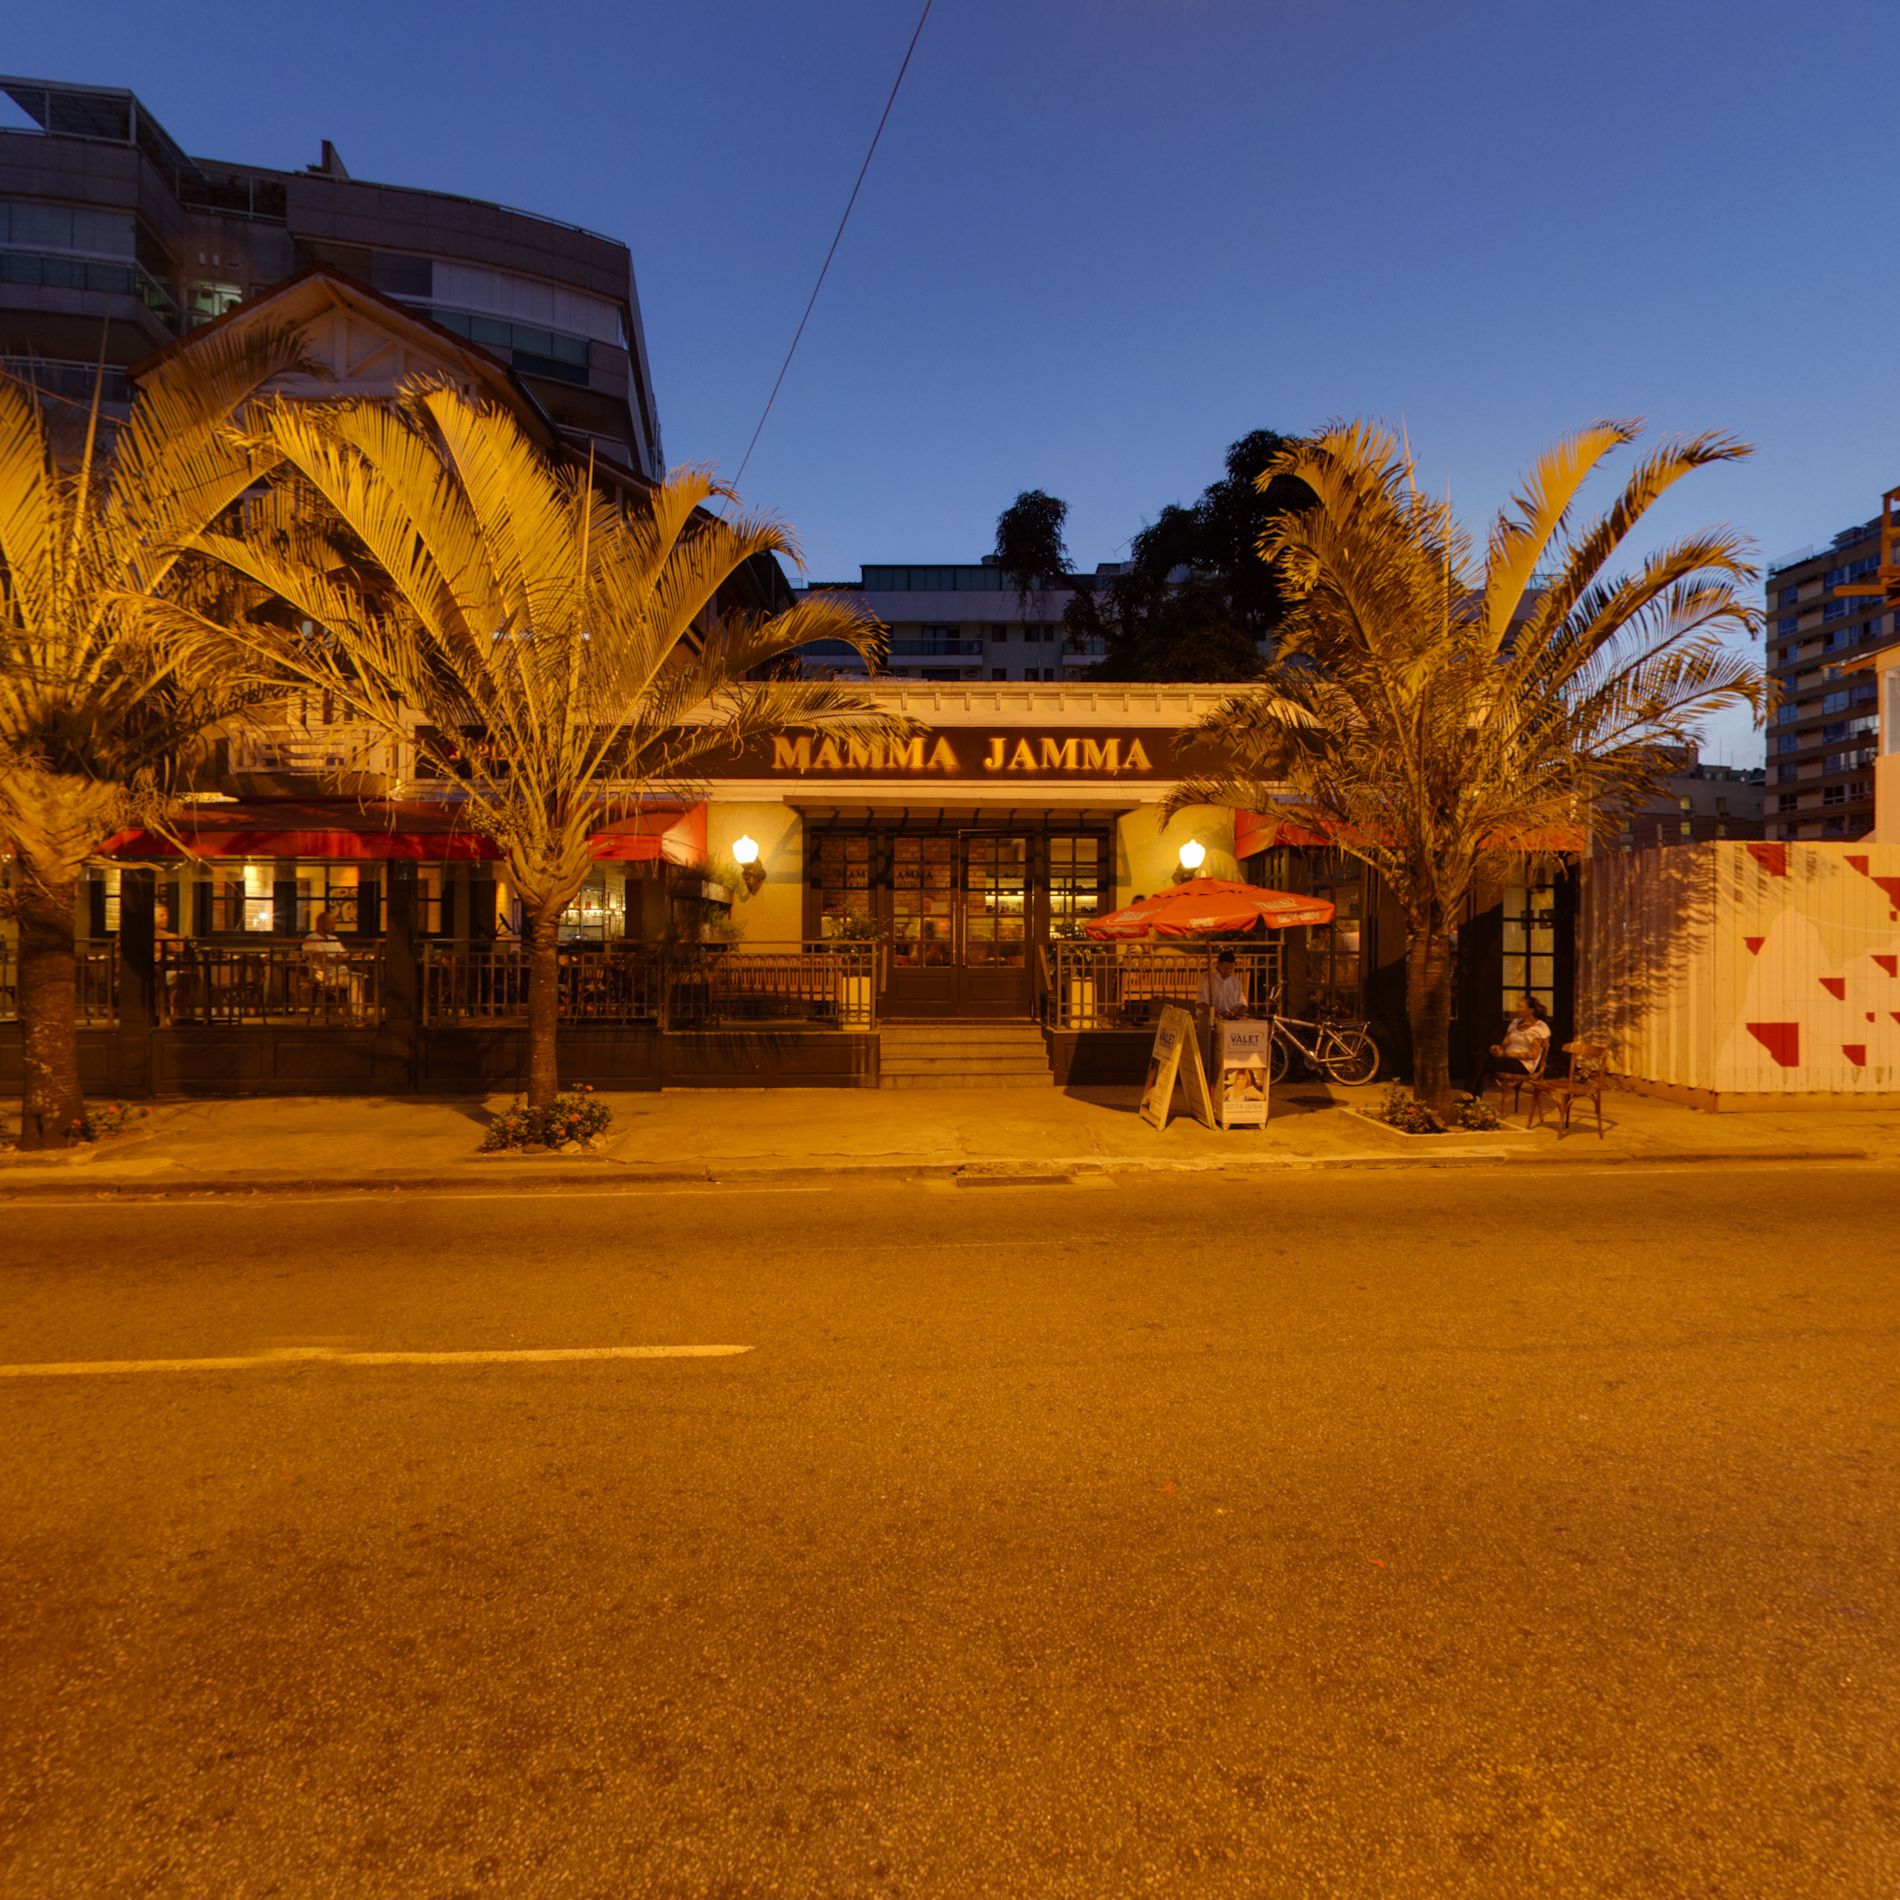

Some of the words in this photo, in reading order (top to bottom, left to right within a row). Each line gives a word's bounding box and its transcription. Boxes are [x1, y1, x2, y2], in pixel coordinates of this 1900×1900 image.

[772, 736, 957, 770] MAMMA
[984, 737, 1152, 770] JAMMA
[1230, 1035, 1260, 1043] VALET
